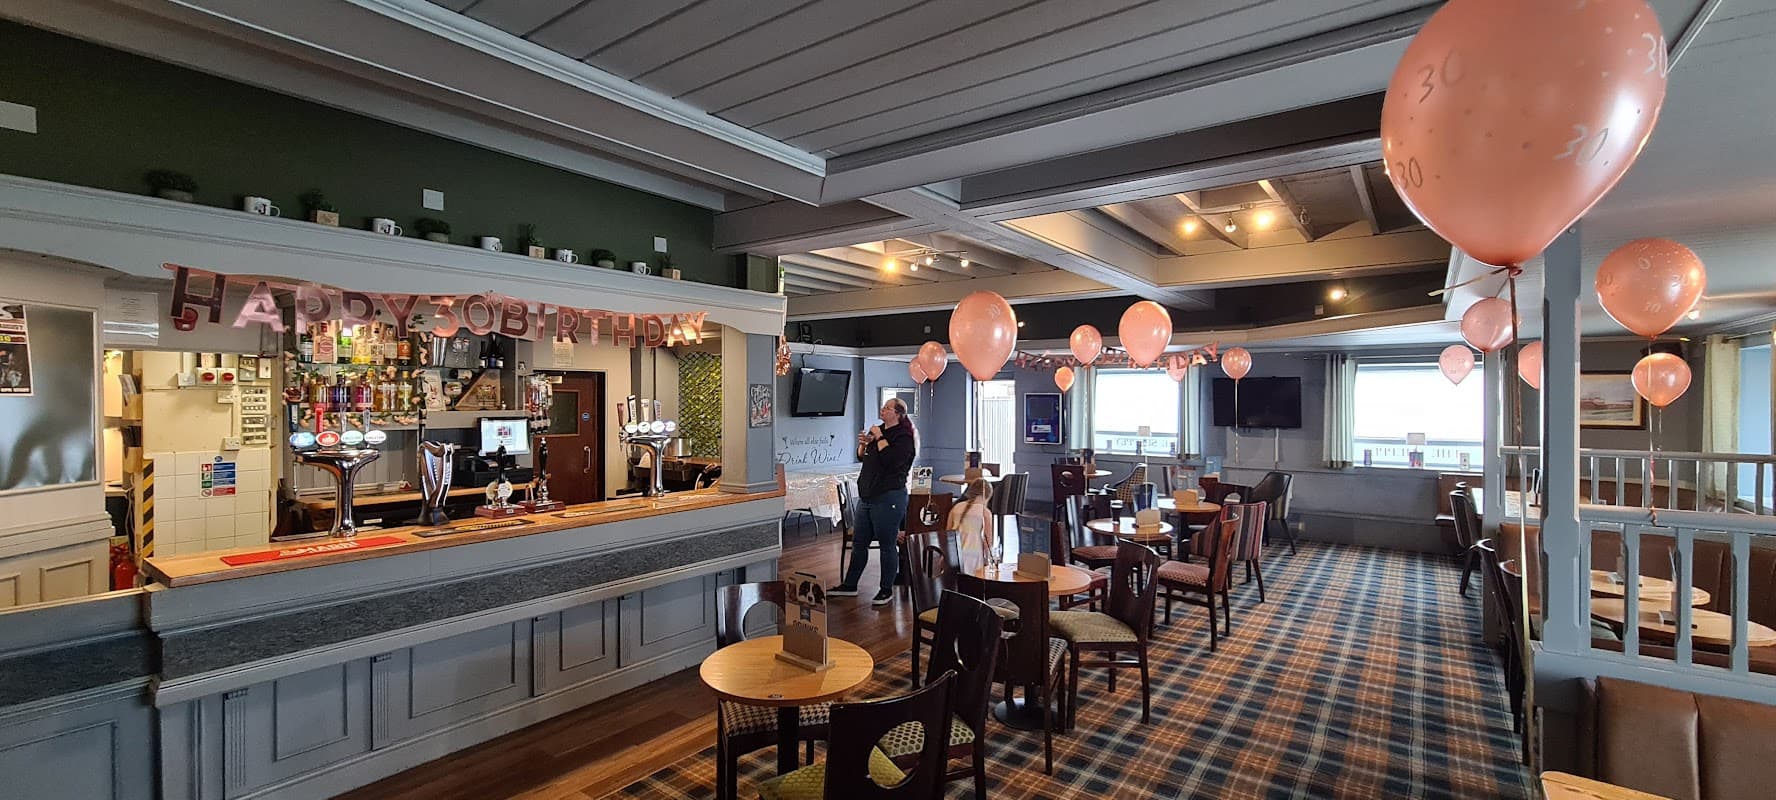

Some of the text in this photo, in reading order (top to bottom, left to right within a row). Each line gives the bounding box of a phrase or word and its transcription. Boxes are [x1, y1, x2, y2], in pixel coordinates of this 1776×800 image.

[1416, 50, 1464, 104] 30
[1642, 32, 1668, 78] 30
[1555, 124, 1609, 167] 30
[1396, 157, 1424, 190] 30
[170, 266, 419, 340] HAPPY
[499, 297, 708, 349] BIRTHDAY
[777, 448, 843, 465] Drink Wine!
